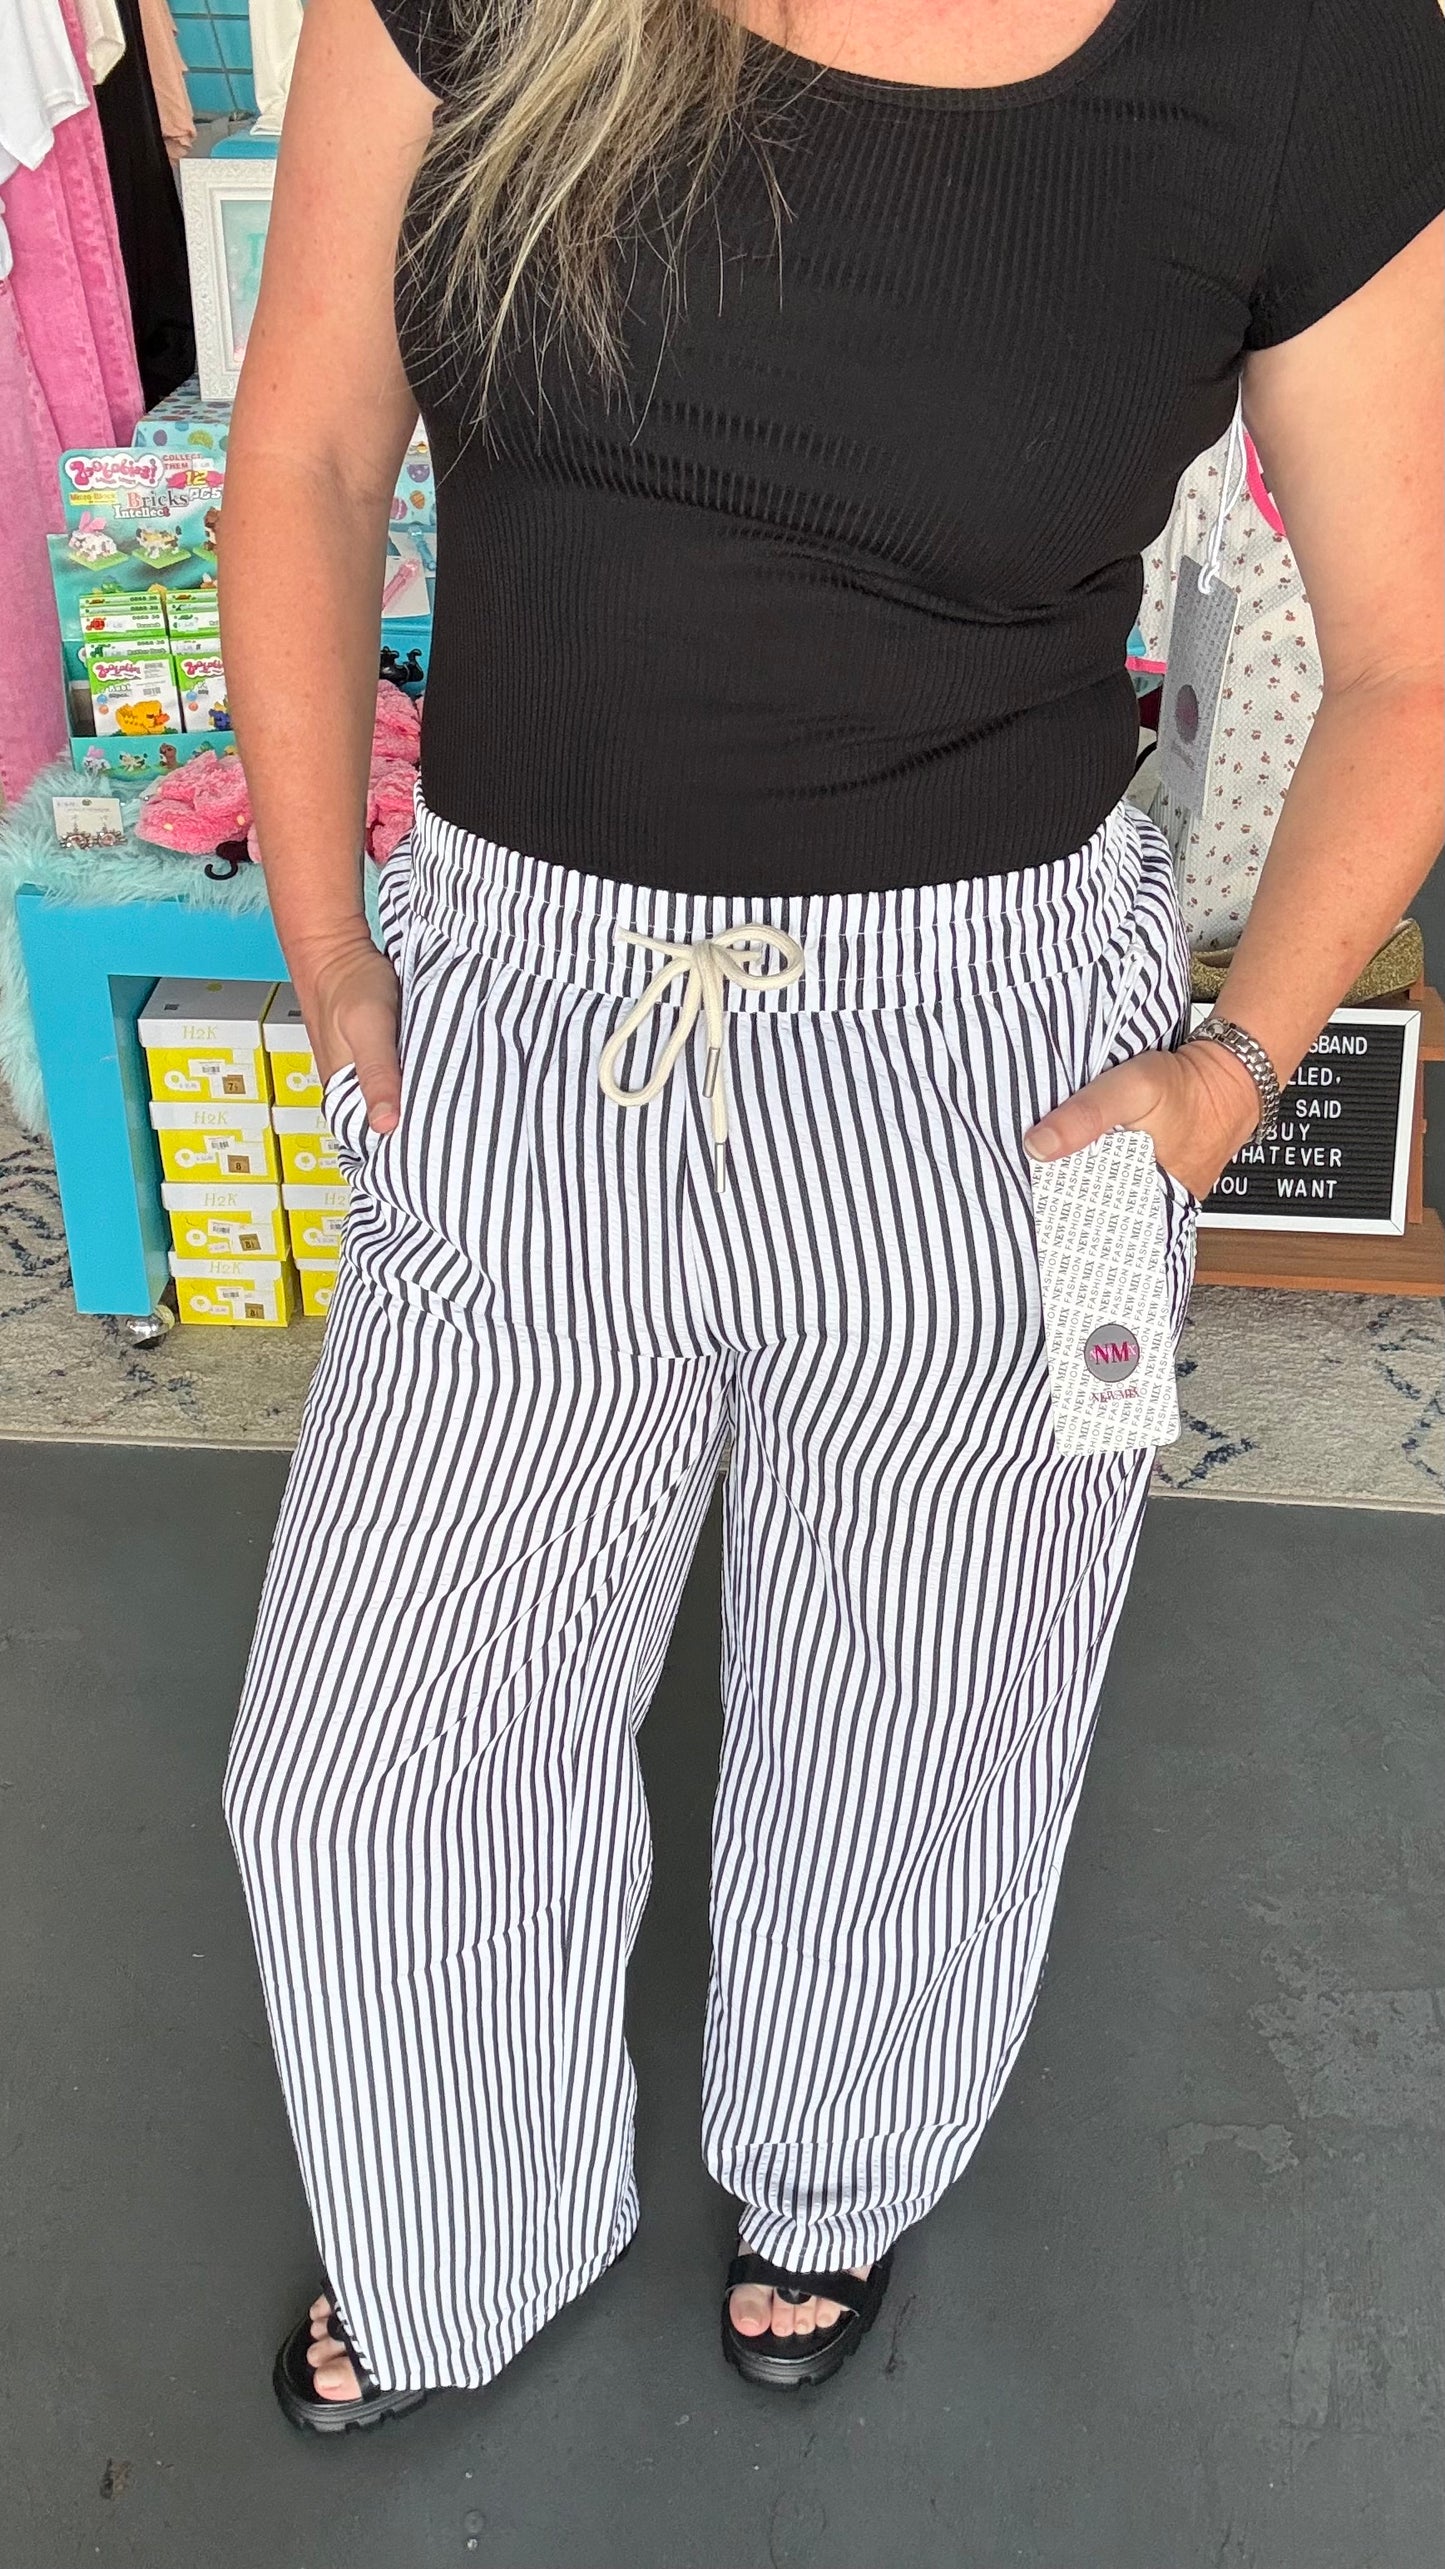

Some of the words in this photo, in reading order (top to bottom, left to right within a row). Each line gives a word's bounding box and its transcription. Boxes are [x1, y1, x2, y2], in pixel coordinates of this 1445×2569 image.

[185, 470, 208, 486] 12
[127, 490, 189, 508] Bricks
[114, 504, 171, 519] Intellect
[182, 1025, 218, 1040] H2K
[1309, 1036, 1368, 1055] SBAND
[194, 1111, 228, 1125] H2K
[1295, 1099, 1342, 1119] SAID
[1113, 1130, 1127, 1157] FASH
[1136, 1134, 1151, 1163] FASH
[1041, 1158, 1057, 1191] FASH
[1083, 1151, 1098, 1175] MIX
[1108, 1160, 1121, 1181] MIX
[1029, 1164, 1043, 1188] NEW
[1132, 1166, 1144, 1187] MIX
[204, 1192, 238, 1206] H2K
[323, 1192, 347, 1206] H2
[1078, 1177, 1090, 1201] NEW
[1102, 1183, 1113, 1207] NEW
[1277, 1178, 1337, 1199] WANT
[1036, 1195, 1048, 1215] MIX
[1042, 1198, 1059, 1244] FASHION
[1054, 1170, 1067, 1194] NEW
[1125, 1191, 1138, 1213] NEW
[1065, 1204, 1082, 1250] FASHION
[1089, 1210, 1106, 1256] FASHION
[1039, 1249, 1059, 1297] FASHION
[1053, 1223, 1065, 1247] NEW
[1059, 1201, 1072, 1222] MIX
[1112, 1217, 1130, 1262] FASHION
[1051, 1330, 1063, 1354] NEW
[1057, 1307, 1070, 1327] MIX
[1064, 1257, 1081, 1303] FASHION
[1077, 1230, 1089, 1254] NEW
[1083, 1207, 1096, 1228] MIX
[1090, 1157, 1107, 1203] FASHION
[1059, 1254, 1071, 1274] MIX
[1082, 1260, 1094, 1281] MIX
[1106, 1267, 1118, 1287] MIX
[1122, 1295, 1134, 1318] NEW
[1129, 1273, 1141, 1292] MIX
[1136, 1222, 1153, 1268] FASHION
[1052, 1277, 1064, 1300] NEW
[1054, 1412, 1068, 1434] MIX
[1062, 1363, 1079, 1409] FASHION
[1073, 1335, 1088, 1360] NEW
[1081, 1313, 1093, 1333] MIX
[1088, 1263, 1105, 1309] FASHION
[1100, 1236, 1112, 1259] NEW
[1107, 1214, 1119, 1234] MIX
[1113, 1163, 1131, 1209] FASHION
[1125, 1137, 1138, 1160] NEW
[1076, 1282, 1088, 1307] NEW
[1151, 1277, 1165, 1299] MIX
[1079, 1420, 1091, 1440] MIX
[1111, 1269, 1128, 1315] FASHION
[1124, 1242, 1136, 1266] NEW
[1131, 1219, 1143, 1238] MIX
[1137, 1169, 1158, 1215] FASHION
[1099, 1289, 1111, 1312] NEW
[1146, 1303, 1158, 1324] NEW
[1063, 1310, 1080, 1356] FASHION
[1103, 1426, 1114, 1445] MIX
[1135, 1275, 1152, 1321] FASHION
[1148, 1248, 1160, 1270] NEW
[1057, 1360, 1069, 1381] MIX
[1130, 1378, 1150, 1426] FASHION
[1145, 1354, 1157, 1377] NEW
[1151, 1331, 1163, 1351] MIX
[1049, 1382, 1064, 1406] NEW
[1073, 1389, 1085, 1413] NEW
[1143, 1408, 1155, 1429] NEW
[1150, 1383, 1162, 1402] MIX
[1119, 1400, 1133, 1424] NEW
[1155, 1386, 1172, 1431] FASHION
[1061, 1414, 1079, 1456] ASHION
